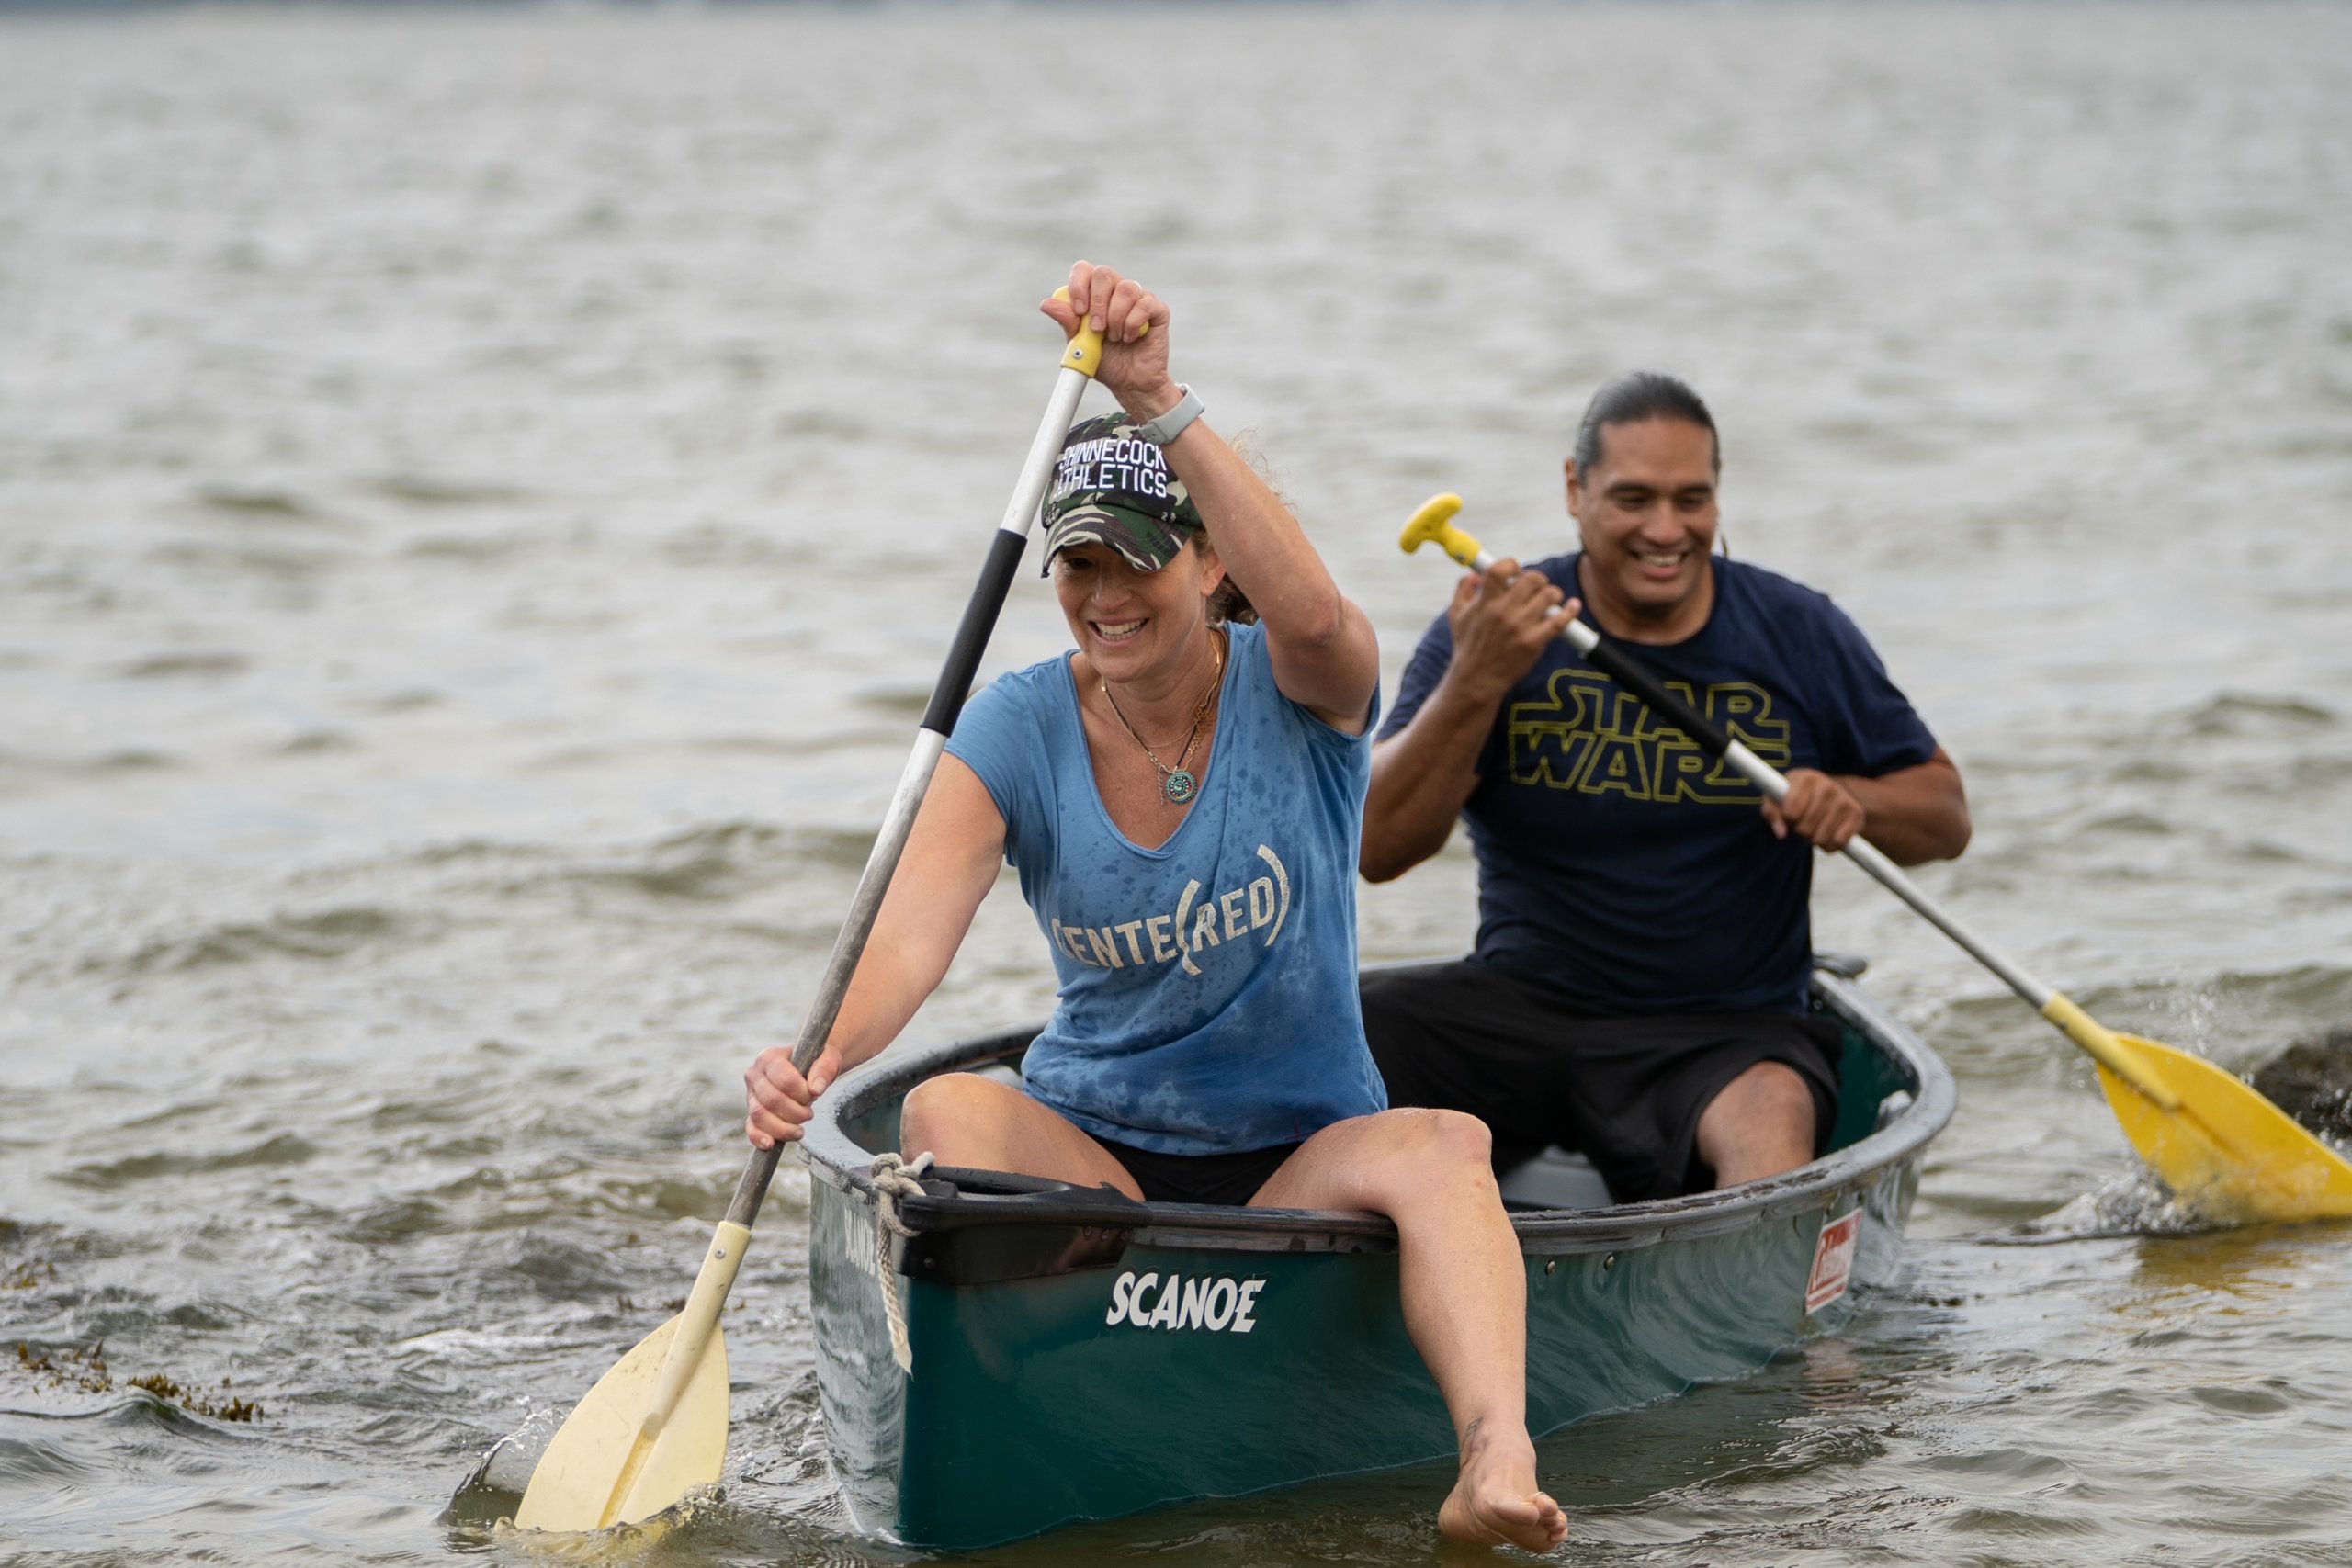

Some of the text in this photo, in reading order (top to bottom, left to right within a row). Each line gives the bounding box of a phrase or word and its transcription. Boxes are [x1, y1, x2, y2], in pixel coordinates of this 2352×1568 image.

[1058, 438, 1167, 471] SHINNECOCK
[1053, 463, 1167, 498] ATHLETICS
[1105, 1271, 1268, 1333] SCANOE
